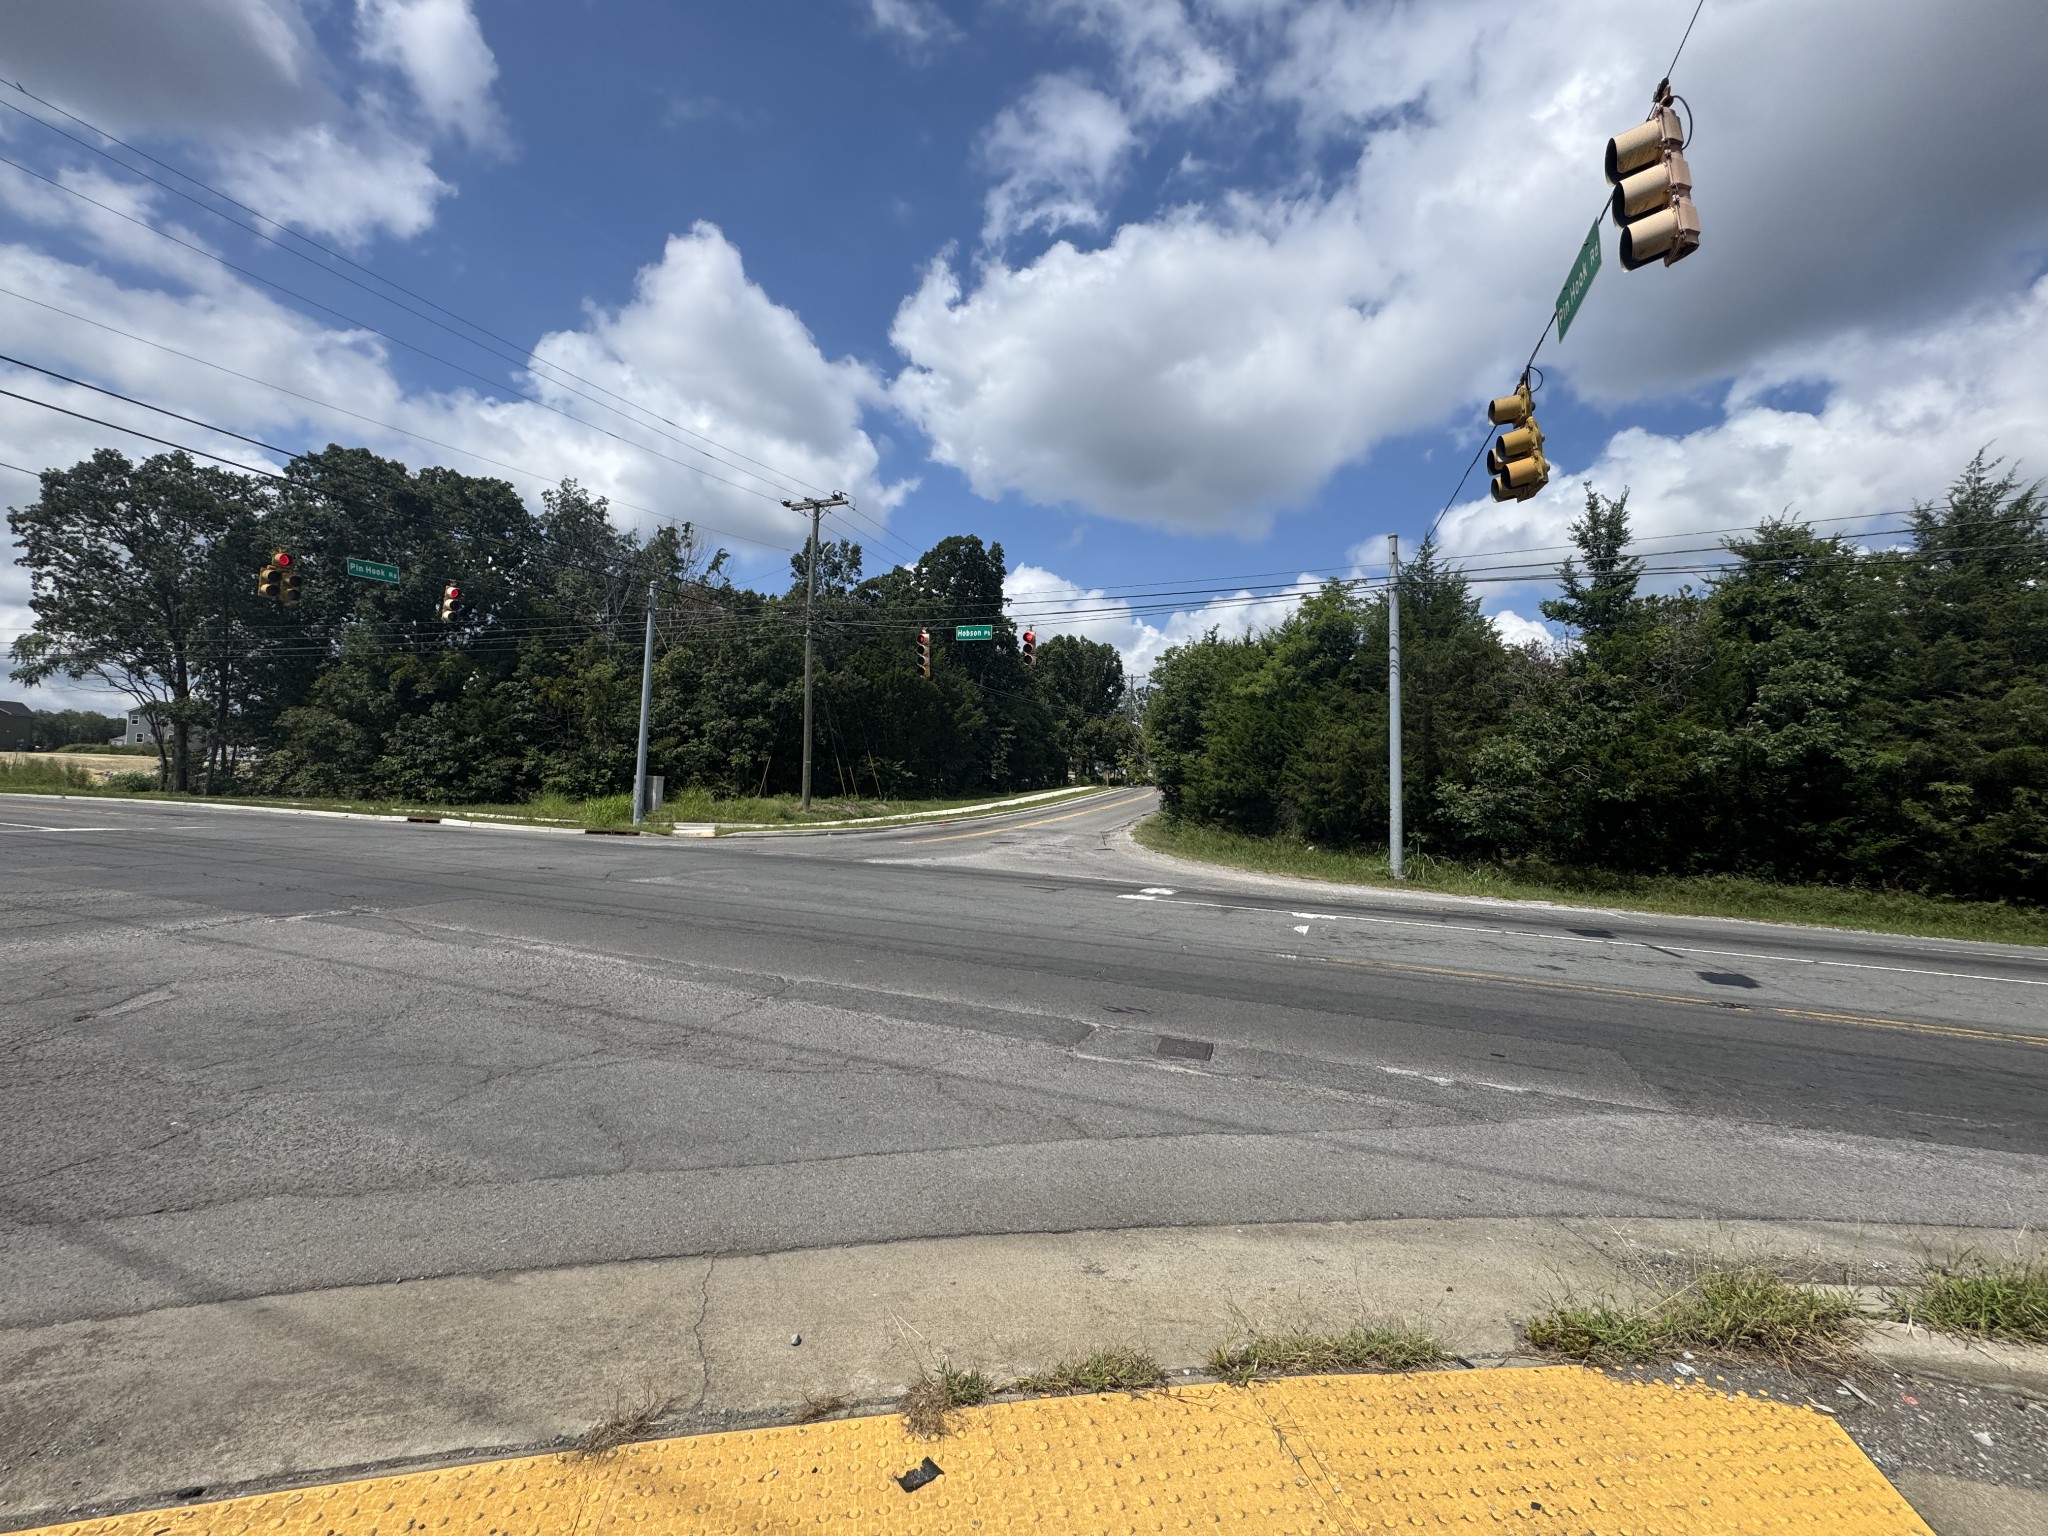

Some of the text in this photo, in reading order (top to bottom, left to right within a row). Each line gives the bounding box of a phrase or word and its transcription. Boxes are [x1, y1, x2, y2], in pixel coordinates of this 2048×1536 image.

[1558, 241, 1599, 329] Pin Hook Rd
[350, 562, 364, 573] Pin
[365, 565, 386, 577] Hook
[957, 629, 982, 637] Hobson
